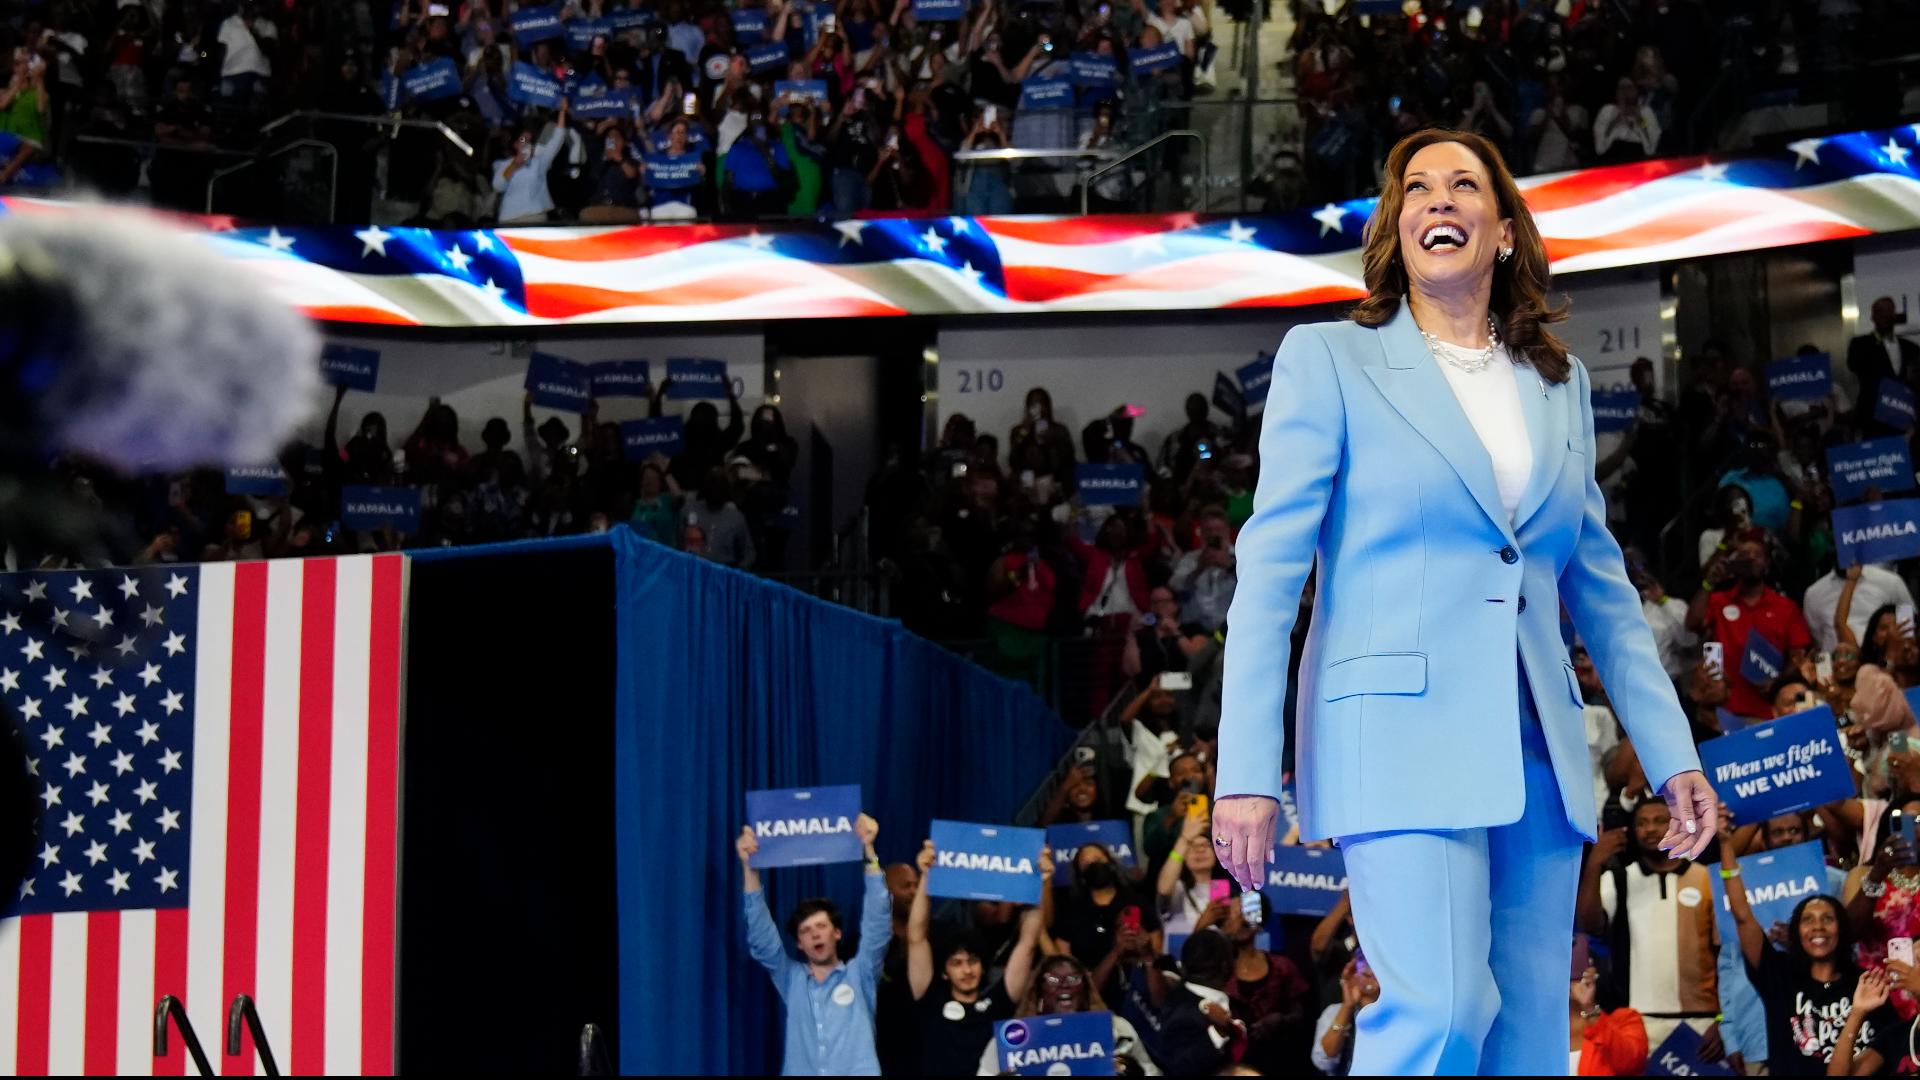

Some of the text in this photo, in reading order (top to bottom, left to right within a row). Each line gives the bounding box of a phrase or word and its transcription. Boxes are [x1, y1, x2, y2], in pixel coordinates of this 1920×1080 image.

[1599, 327, 1639, 353] 211
[958, 369, 1004, 394] 210
[627, 431, 679, 446] KAMALA
[1842, 519, 1918, 546] KAMALA
[1715, 738, 1833, 784] When we fight,
[1735, 763, 1823, 799] WE WIN.
[755, 815, 853, 838] KAMALA
[938, 850, 1034, 874] KAMALA
[1056, 843, 1132, 863] KLA
[1269, 870, 1348, 892] KAMALA
[1006, 1041, 1106, 1069] KAMALA
[1660, 1051, 1699, 1077] KA
